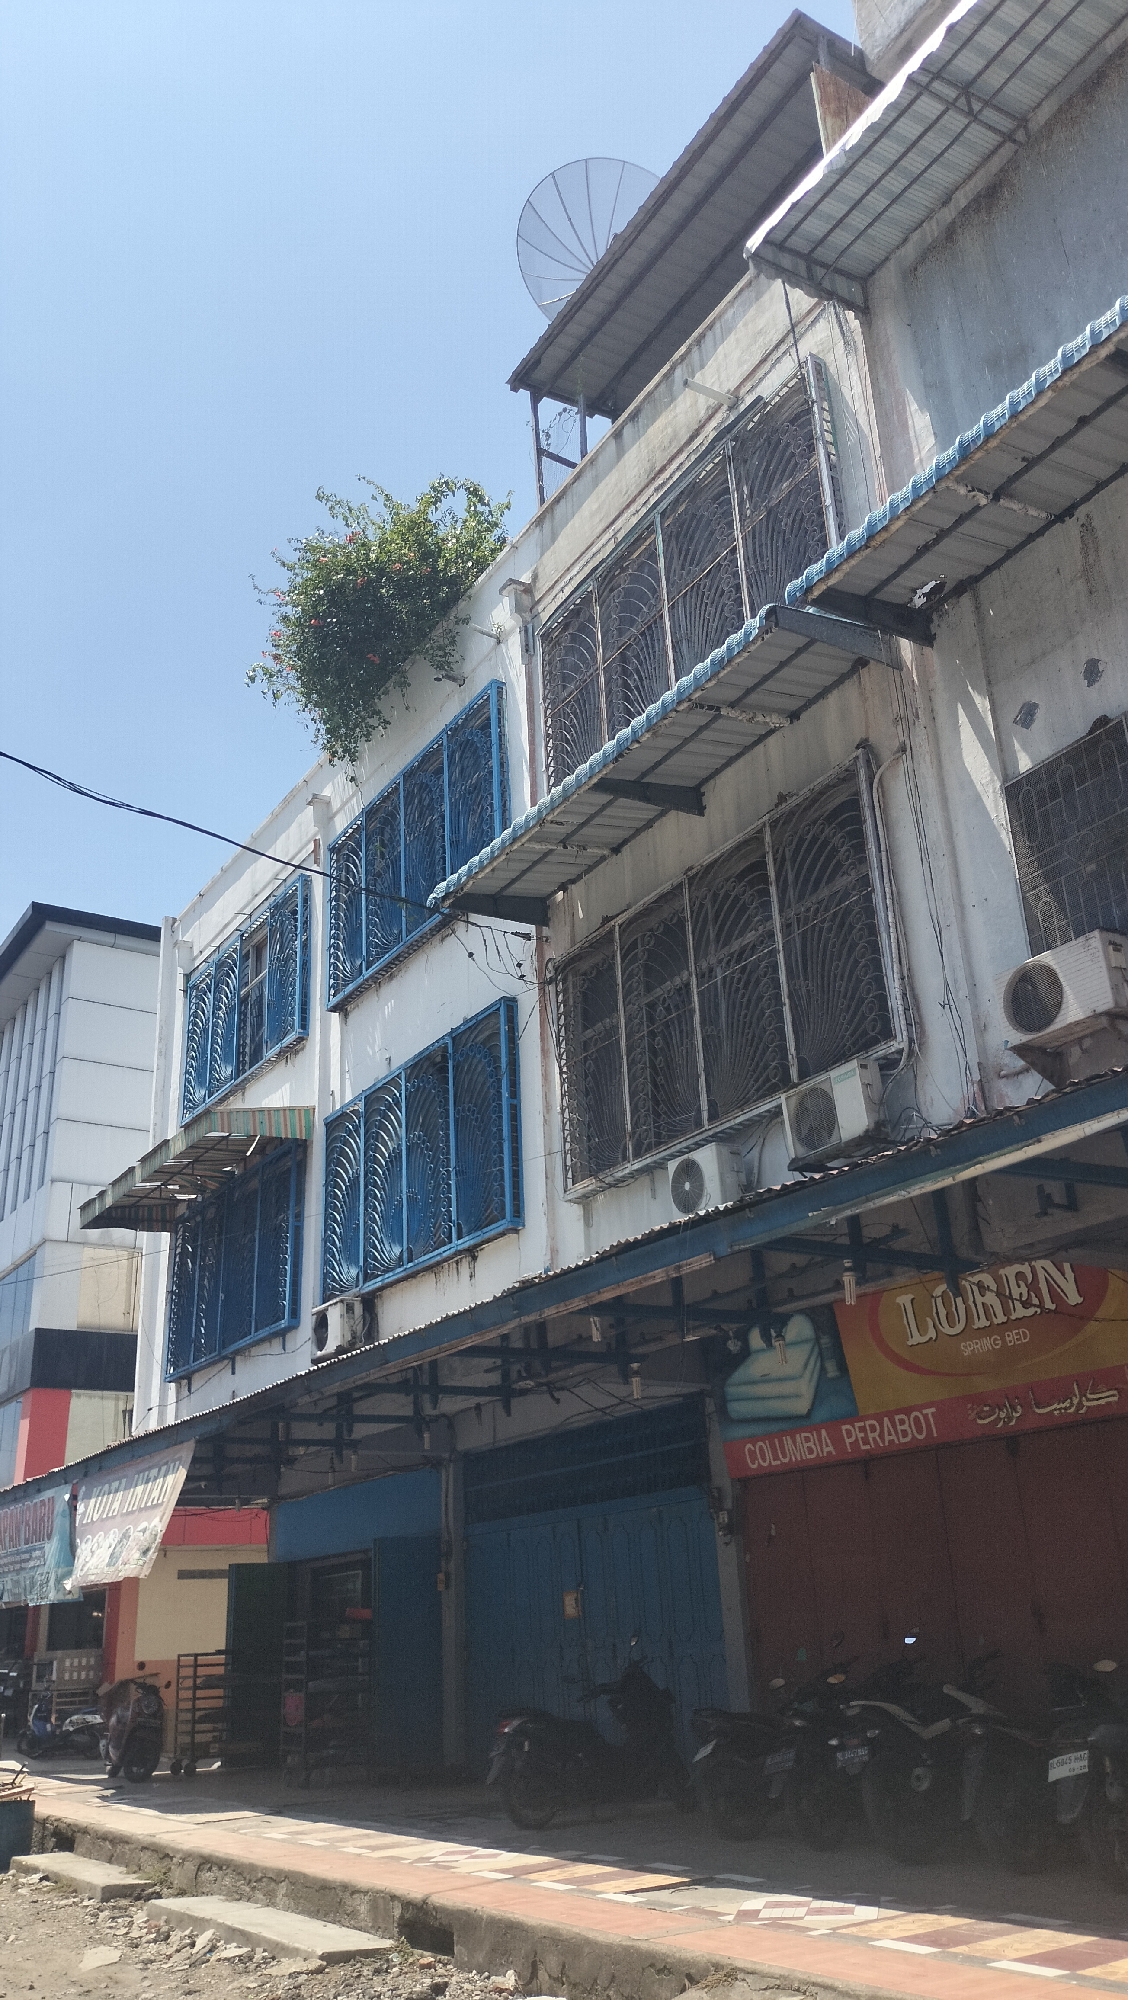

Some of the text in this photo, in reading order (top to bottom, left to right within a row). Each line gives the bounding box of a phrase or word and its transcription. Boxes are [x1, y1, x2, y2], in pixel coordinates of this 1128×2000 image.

[896, 1259, 1084, 1347] LOREN
[960, 1328, 1031, 1356] SPRING BED
[744, 1407, 938, 1470] COLUMBIA PERABOT
[24, 1495, 55, 1546] BARU
[83, 1461, 181, 1524] KOTA INTAN
